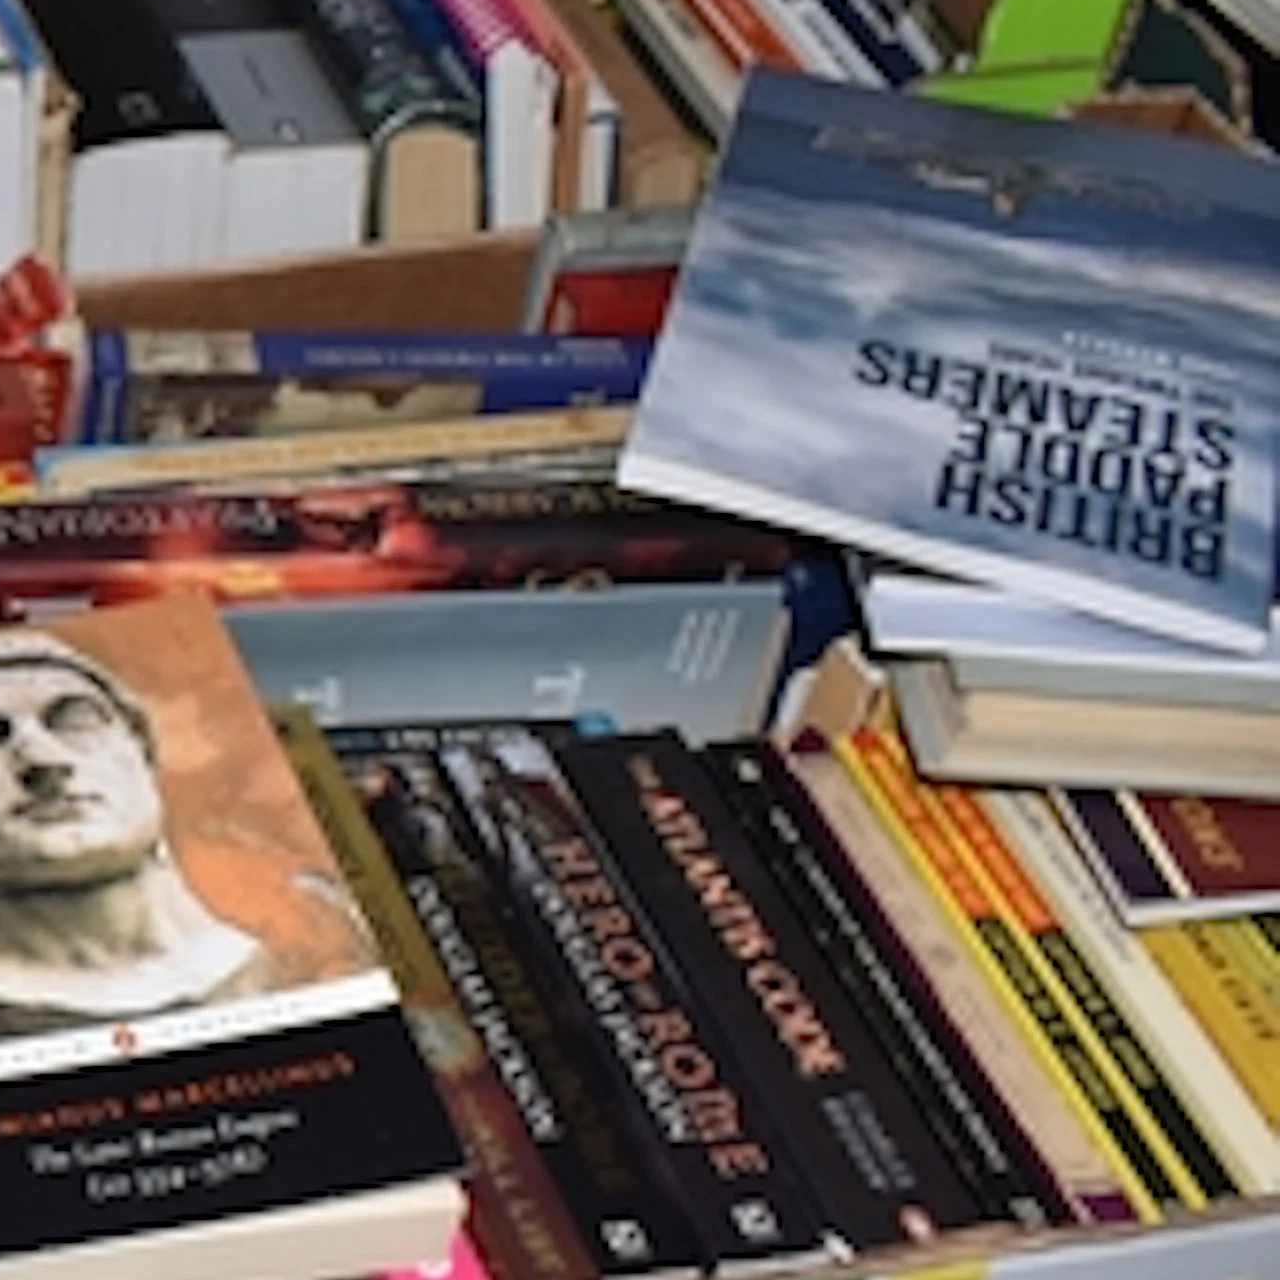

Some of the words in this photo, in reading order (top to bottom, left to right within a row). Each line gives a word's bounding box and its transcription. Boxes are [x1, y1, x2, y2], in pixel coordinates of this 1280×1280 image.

[854, 338, 1237, 471] STEAMERS
[950, 417, 1228, 525] PADDLE
[934, 461, 1225, 582] BRITISH
[642, 788, 777, 962] ATLANTIS
[745, 956, 847, 1081] CODE
[539, 833, 658, 981] HERO
[640, 1008, 772, 1180] ROME
